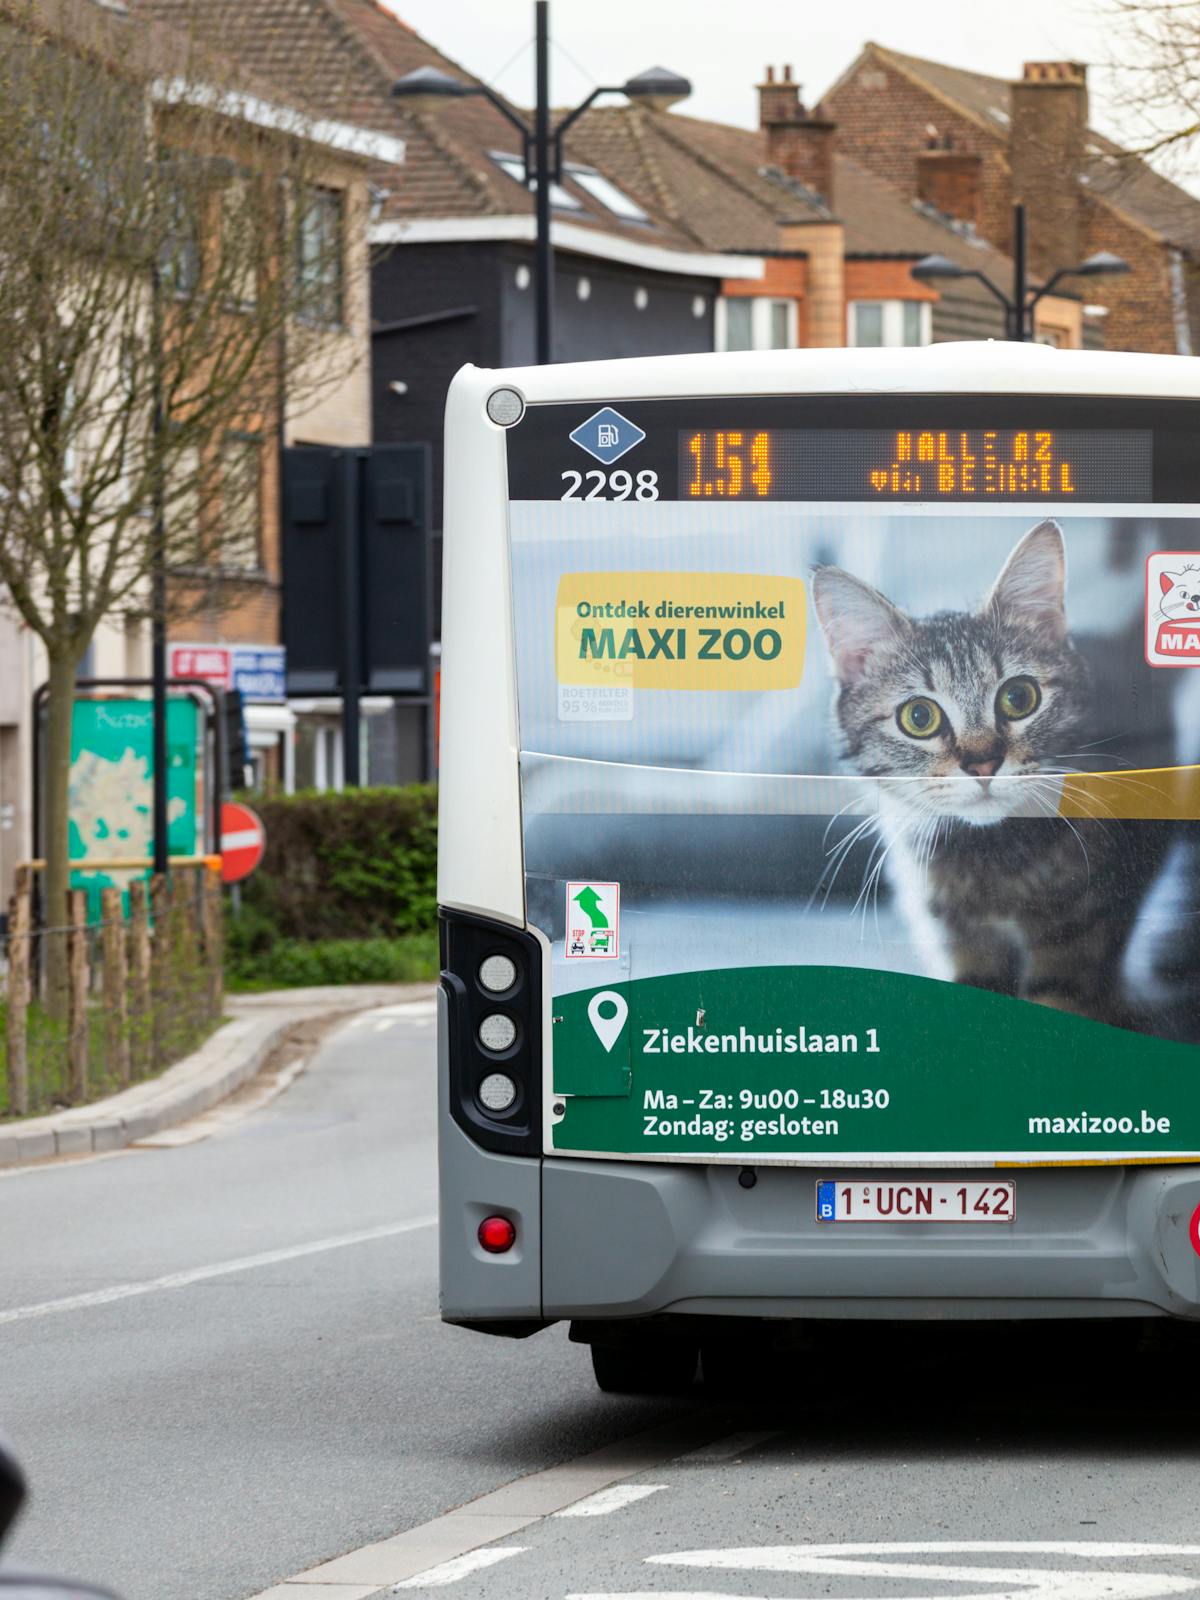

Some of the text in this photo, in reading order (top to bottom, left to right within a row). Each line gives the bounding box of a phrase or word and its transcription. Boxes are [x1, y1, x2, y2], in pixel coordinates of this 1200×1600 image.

[688, 432, 771, 496] 154
[561, 470, 660, 501] 2298
[576, 601, 785, 619] Ontdek dierenwinkel
[579, 628, 783, 661] MAXI ZOO
[643, 1027, 880, 1053] Ziekenhuislaan 1
[643, 1114, 839, 1142] Zondag: gesloten
[1028, 1110, 1171, 1134] maxizoo.be
[821, 1204, 833, 1218] B
